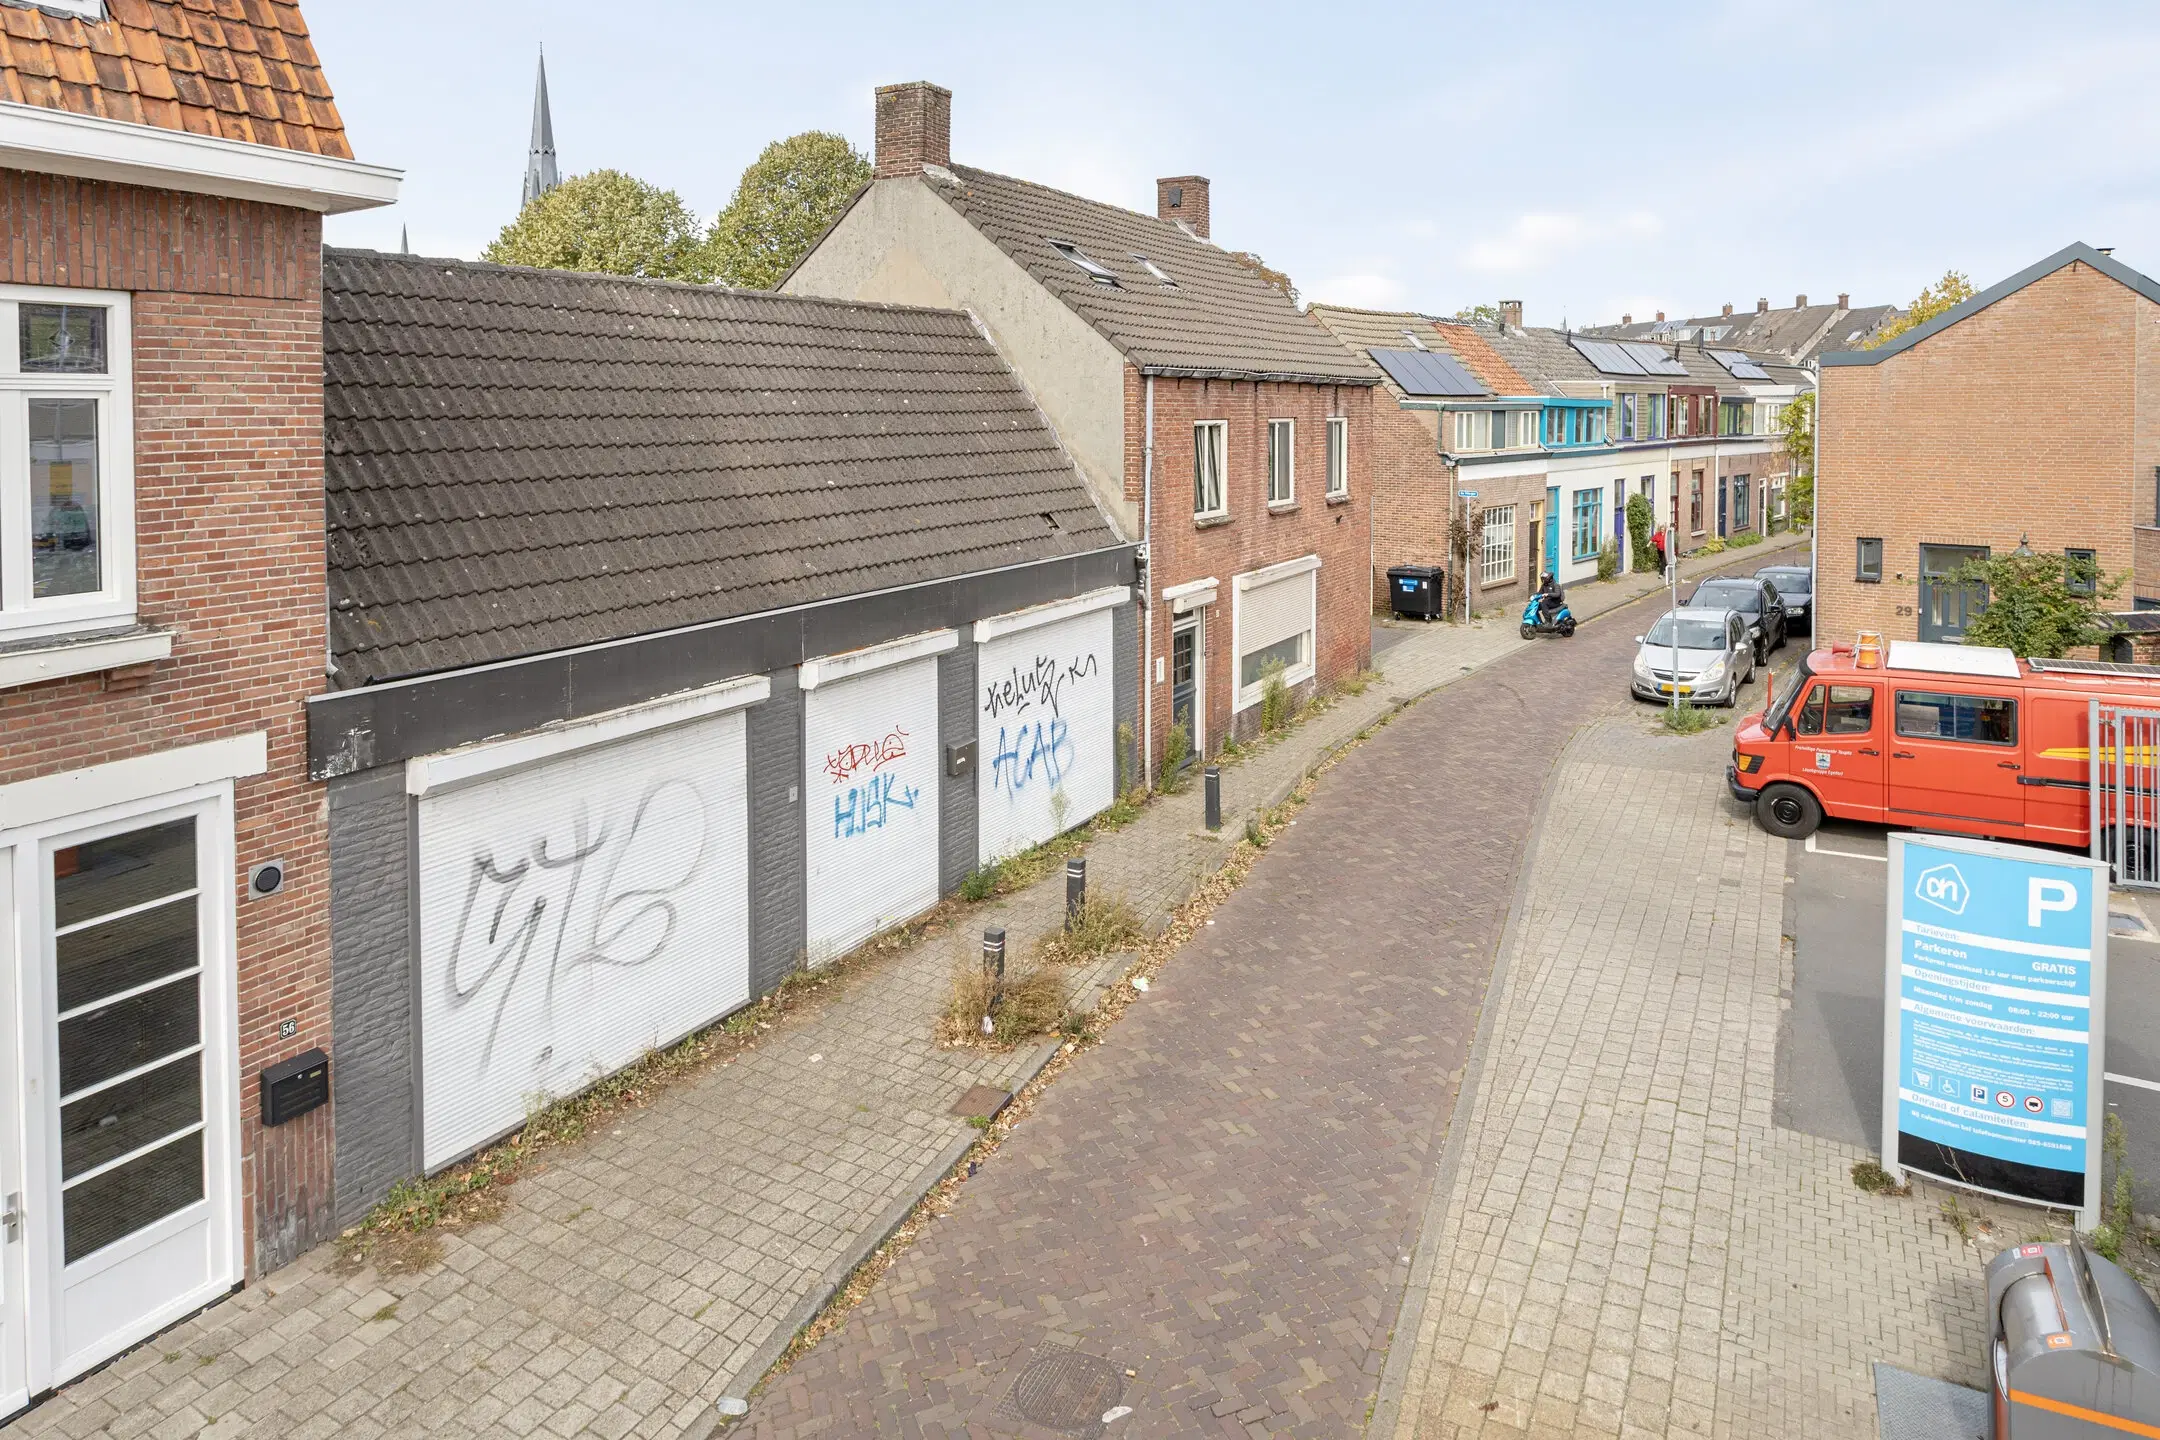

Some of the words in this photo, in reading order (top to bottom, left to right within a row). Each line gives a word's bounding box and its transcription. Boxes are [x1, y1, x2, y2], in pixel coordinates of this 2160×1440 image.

[1896, 605, 1913, 617] 29
[992, 717, 1075, 800] ACAB
[2028, 876, 2079, 928] P
[1916, 925, 1960, 940] Tarieven:
[1914, 939, 1967, 960] Parkeren
[1913, 953, 1946, 966] Parkeren
[1947, 962, 1983, 974] maximaal
[2011, 974, 2027, 982] met
[2028, 976, 2077, 988] parkeerschijf
[2032, 961, 2077, 975] GRATIS
[1914, 968, 1989, 993] Openingstijden:
[1948, 994, 1964, 1004] t/m
[1964, 999, 1993, 1011] zondag
[1914, 1003, 1963, 1022] Algemene
[1965, 1016, 2036, 1035] voorwaarden:
[2008, 1006, 2031, 1016] 08:00
[2037, 1010, 2060, 1020] 22:00
[283, 1021, 295, 1036] 56
[1975, 1088, 1983, 1097] P
[2002, 1095, 2009, 1103] 5
[1950, 1105, 1960, 1113] of
[1963, 1108, 2029, 1129] calamiteiten:
